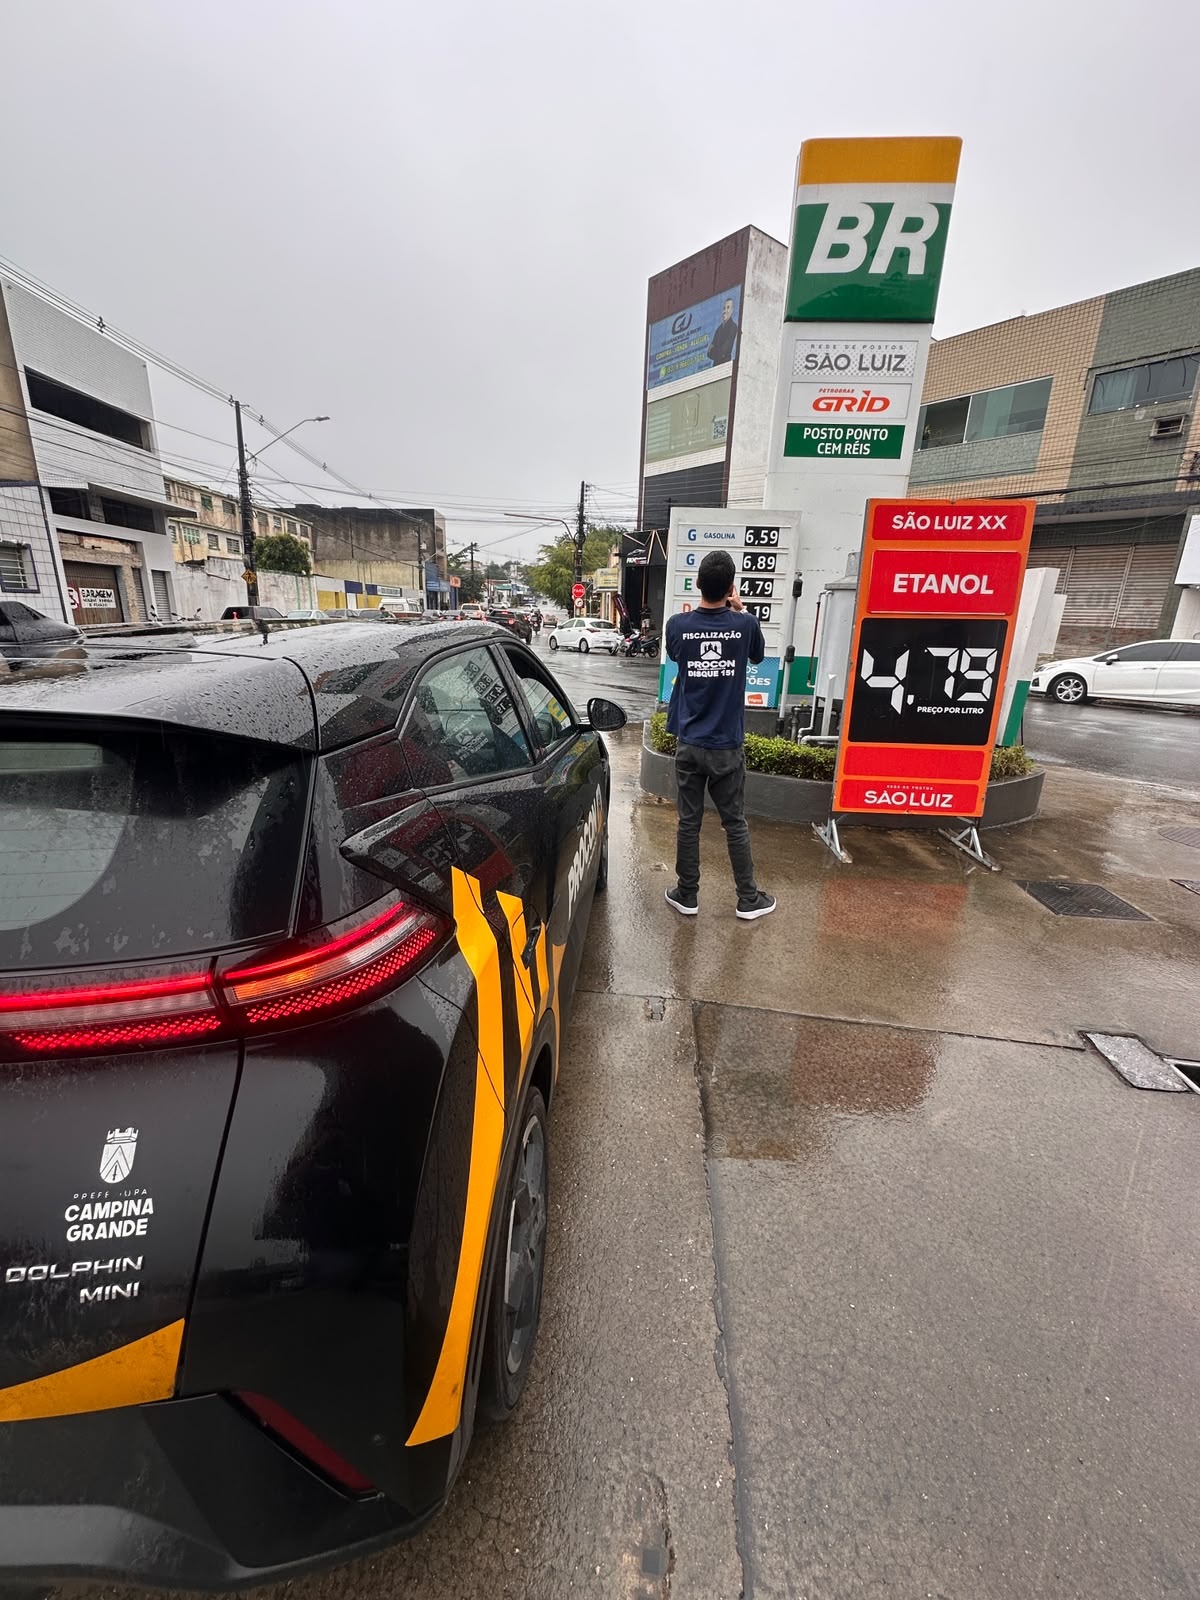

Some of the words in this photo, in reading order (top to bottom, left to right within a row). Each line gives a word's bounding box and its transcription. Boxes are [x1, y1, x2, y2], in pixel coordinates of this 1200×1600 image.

[805, 202, 940, 275] BR
[858, 354, 906, 371] LUIZ
[812, 390, 891, 413] GRID
[804, 428, 844, 439] POSTO
[846, 428, 888, 440] PONTO
[817, 443, 841, 454] CEM
[844, 441, 870, 455] RÉIS
[892, 512, 930, 530] SÃO
[934, 516, 973, 530] LUIZ
[977, 516, 1008, 530] XX
[688, 529, 696, 541] G
[746, 530, 778, 545] 6,59
[686, 554, 695, 565] G
[743, 556, 775, 570] 6,89
[684, 578, 692, 590] E
[740, 581, 772, 596] 4,79
[893, 573, 994, 595] ETANOL
[683, 603, 691, 613] D
[682, 631, 742, 640] FISCALIZAÇÃO
[687, 660, 735, 668] PROCON
[746, 675, 771, 685] ÕES
[917, 706, 943, 714] PREÇO
[910, 792, 953, 808] LUIZ
[65, 1198, 154, 1222] CAMPINA
[66, 1218, 148, 1242] GRANDE
[5, 1256, 143, 1283] DOLPHIN
[80, 1282, 139, 1304] MINI
